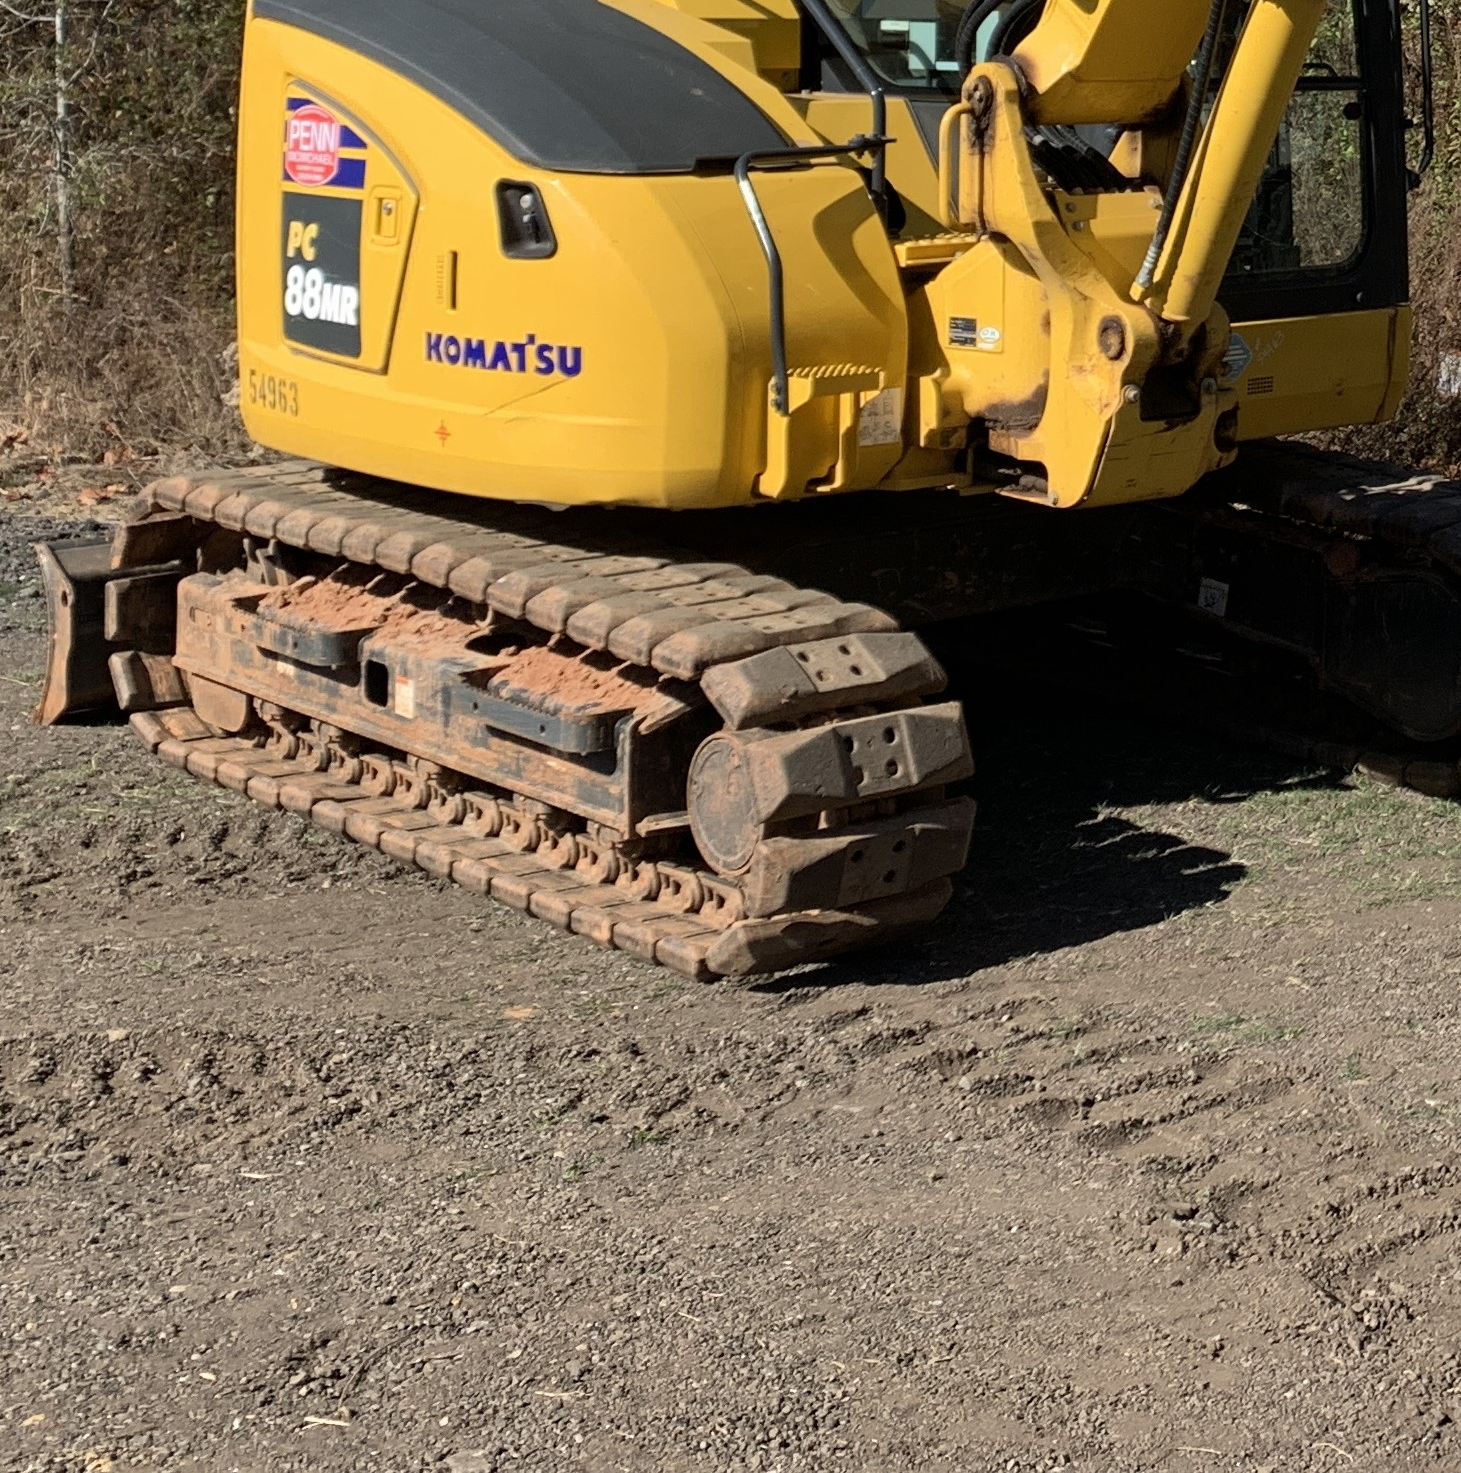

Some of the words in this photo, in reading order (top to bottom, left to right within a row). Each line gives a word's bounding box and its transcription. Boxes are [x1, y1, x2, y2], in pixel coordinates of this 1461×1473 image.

[289, 119, 336, 153] PENN
[287, 220, 319, 261] PC
[284, 264, 359, 326] 88MR
[425, 331, 583, 379] KOMATSU
[249, 369, 299, 417] 54963
